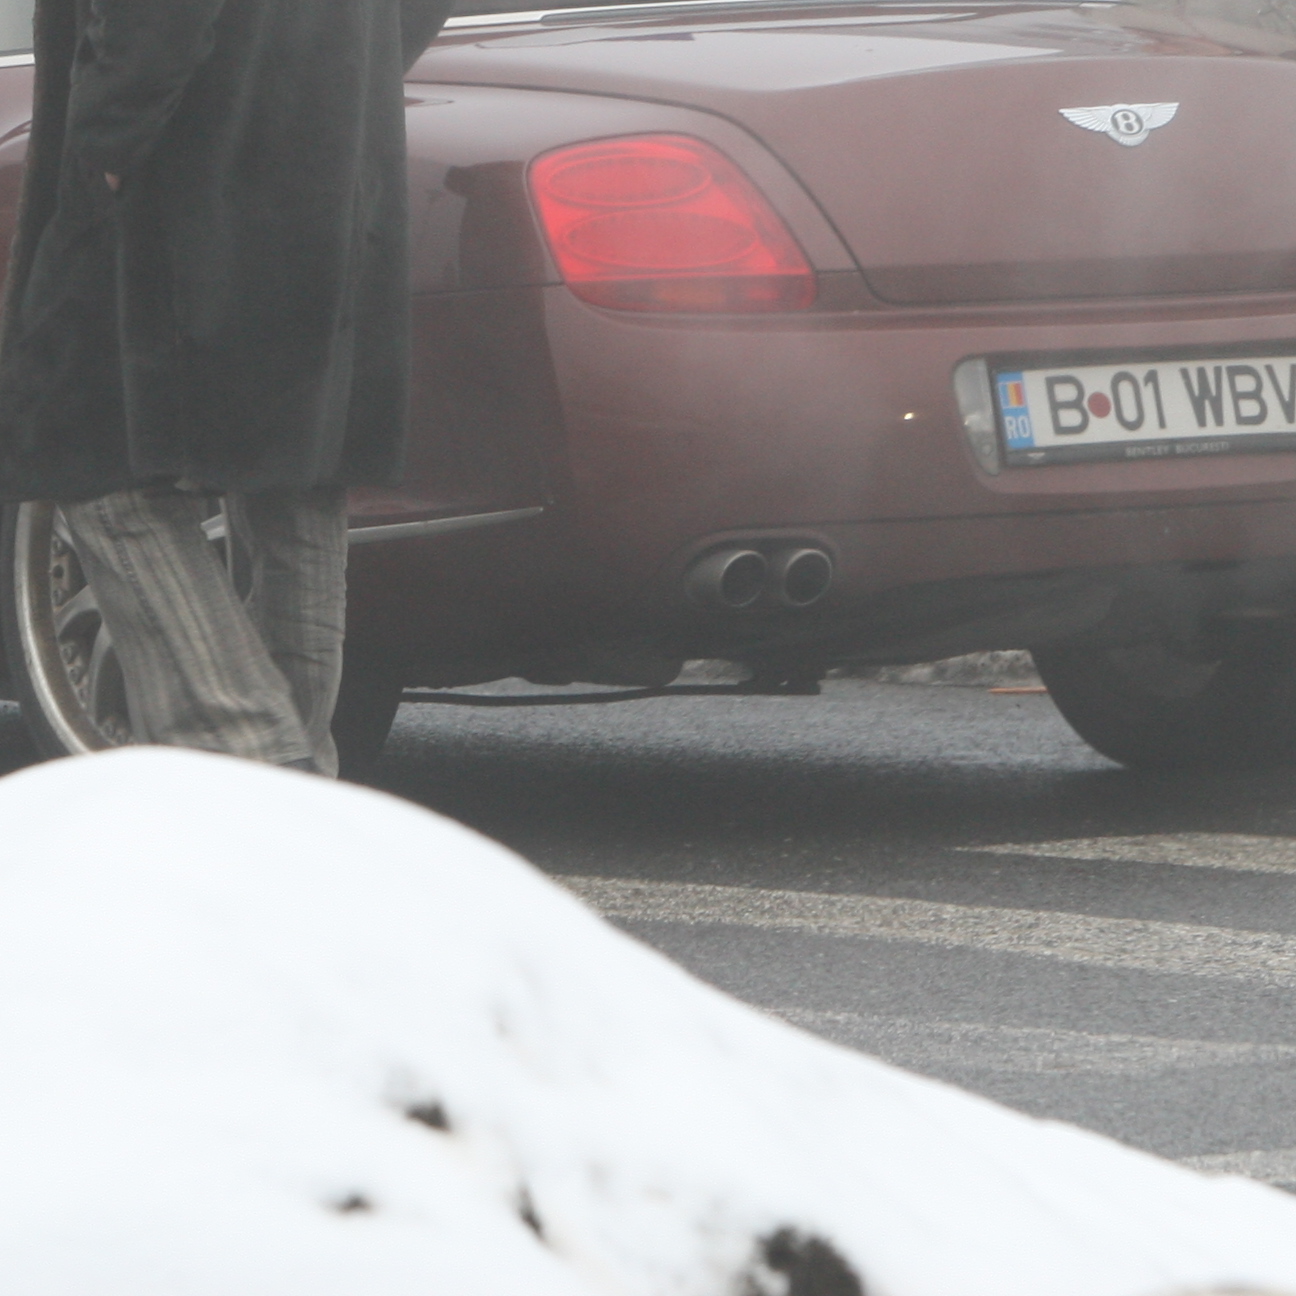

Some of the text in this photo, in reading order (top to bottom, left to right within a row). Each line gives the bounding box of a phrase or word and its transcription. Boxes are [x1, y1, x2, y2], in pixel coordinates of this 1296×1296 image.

[1045, 375, 1090, 435] B
[1111, 369, 1167, 432] 01
[1005, 415, 1031, 439] RO
